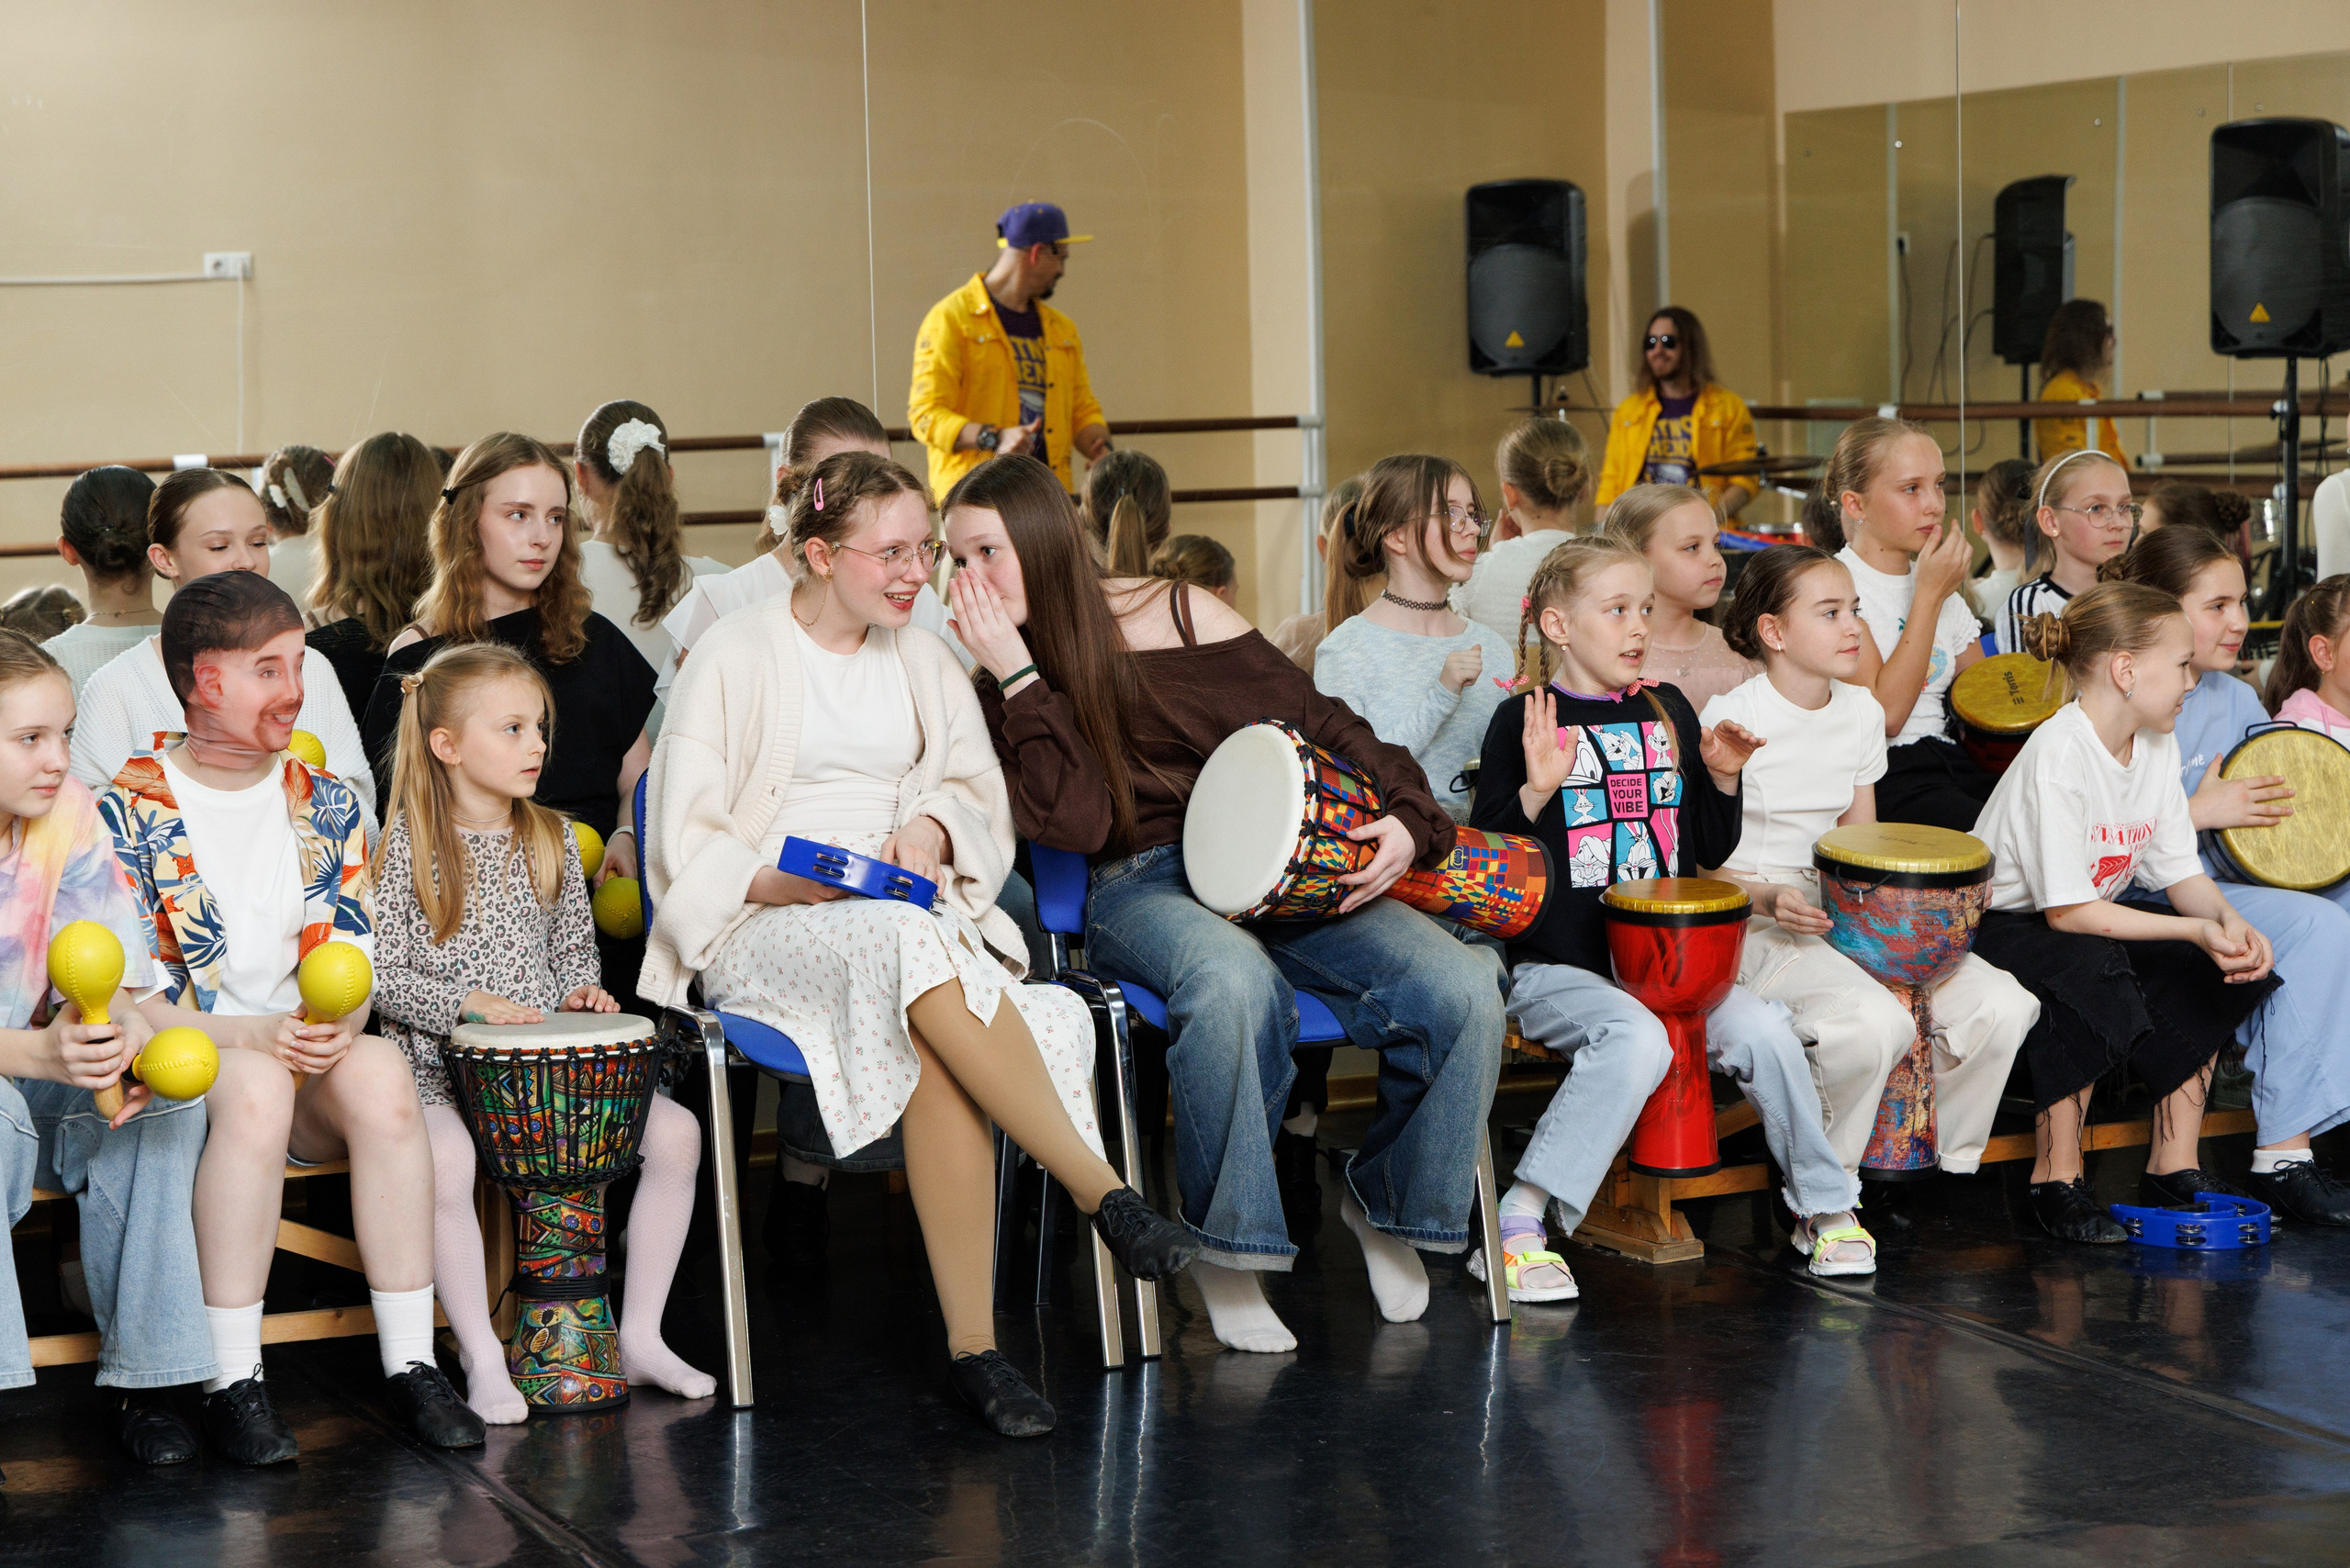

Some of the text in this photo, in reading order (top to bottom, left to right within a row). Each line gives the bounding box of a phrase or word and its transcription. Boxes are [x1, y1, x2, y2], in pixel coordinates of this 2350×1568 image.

[2002, 671, 2020, 697] Terris
[1610, 778, 1642, 788] DECIDE
[1612, 789, 1642, 800] YOUR
[1614, 801, 1644, 813] VIBE
